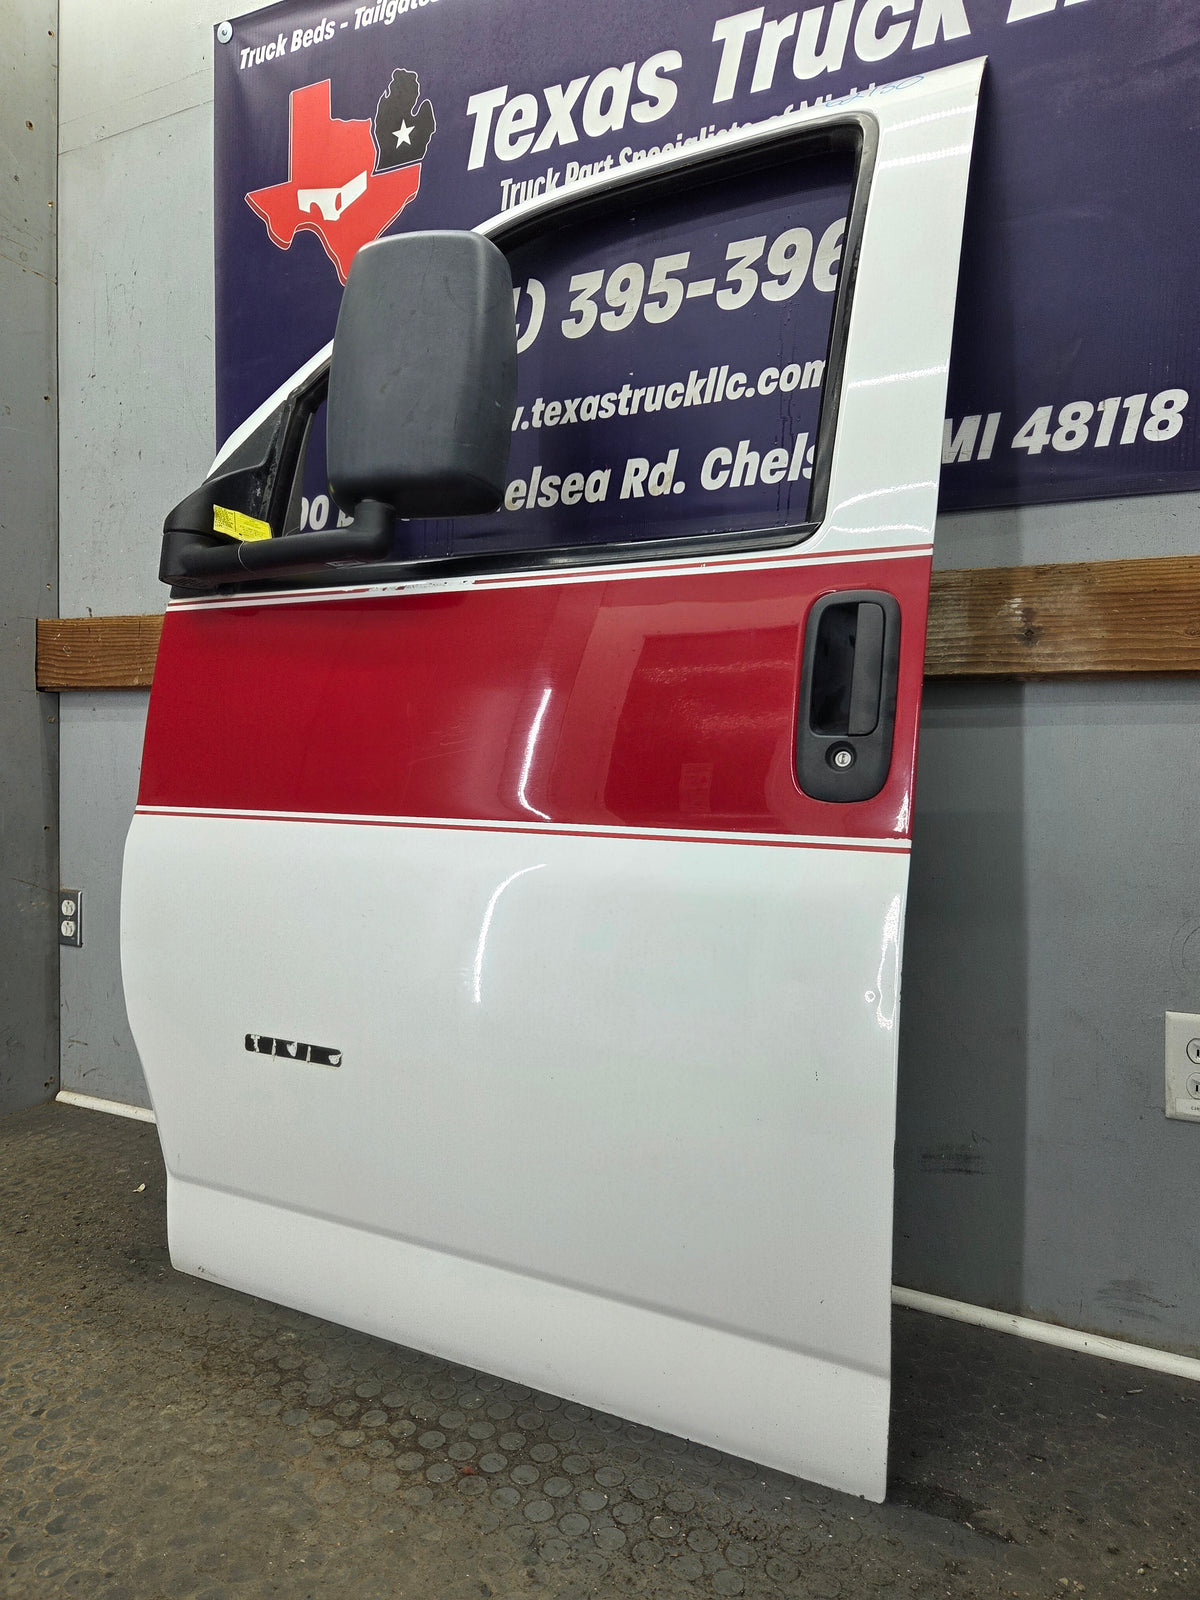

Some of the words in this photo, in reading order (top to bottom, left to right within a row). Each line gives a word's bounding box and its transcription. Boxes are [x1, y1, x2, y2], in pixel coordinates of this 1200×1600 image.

[239, 33, 289, 70] Truck
[290, 18, 336, 53] Beds
[339, 22, 349, 30] -
[467, 49, 683, 171] Texas
[500, 167, 561, 212] Truck
[510, 360, 827, 432] .texastruckllc.com
[499, 466, 612, 513] elsea
[619, 449, 686, 500] Rd.
[941, 412, 1002, 464] MI
[1011, 388, 1190, 455] 48118
